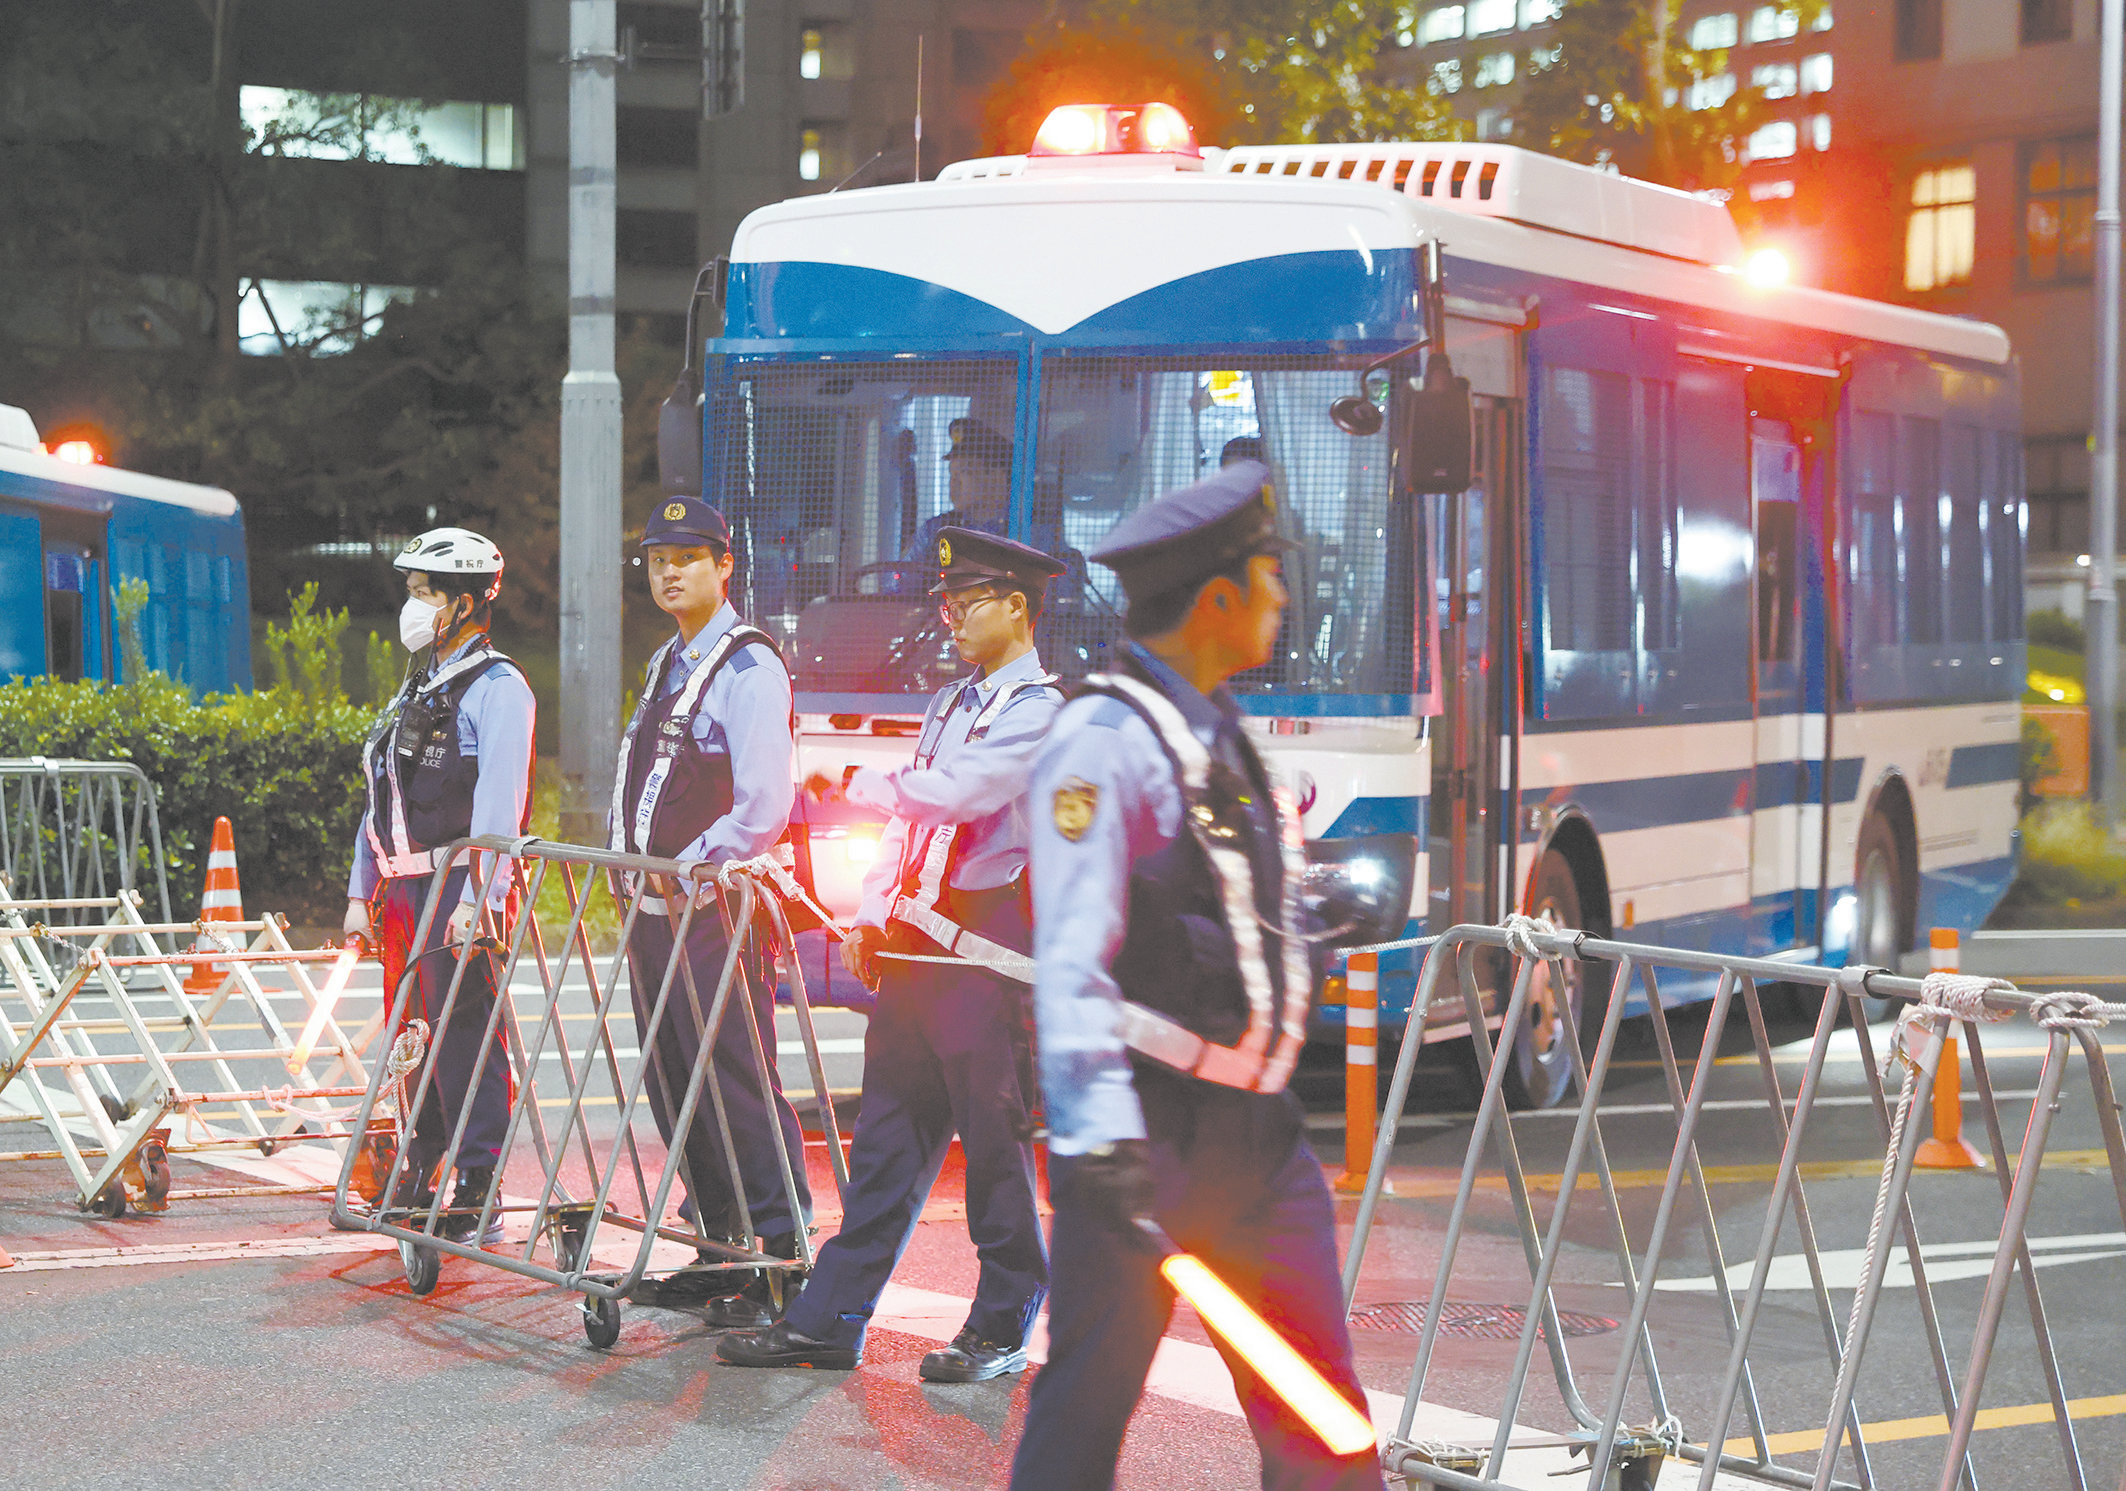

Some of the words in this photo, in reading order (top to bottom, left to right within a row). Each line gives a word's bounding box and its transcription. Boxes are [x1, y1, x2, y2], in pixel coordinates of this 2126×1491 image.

[454, 559, 484, 569] 警視庁
[424, 745, 447, 759] 視庁
[420, 757, 442, 769] OLICE
[637, 772, 663, 826] 警視庁
